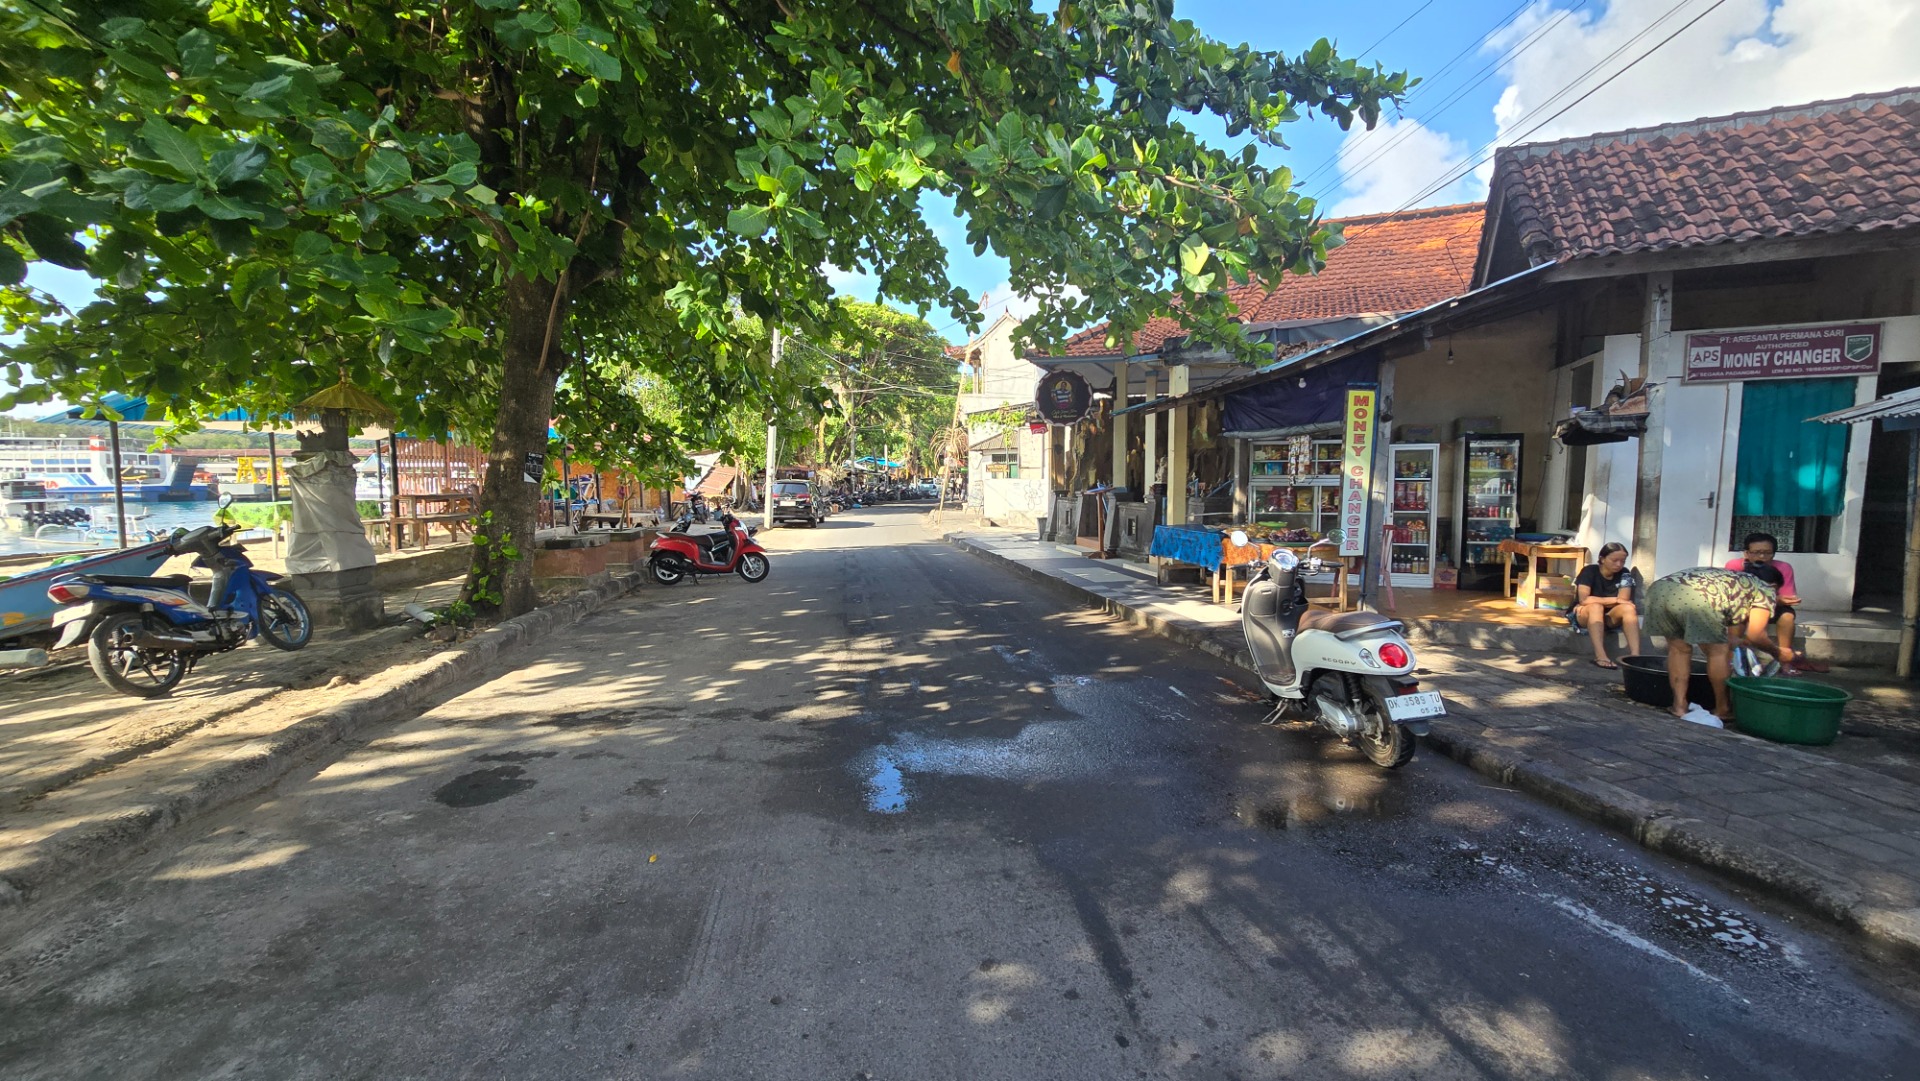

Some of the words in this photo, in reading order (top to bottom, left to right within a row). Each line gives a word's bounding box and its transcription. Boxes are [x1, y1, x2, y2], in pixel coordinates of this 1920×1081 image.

[1720, 336, 1731, 344] PT.
[1732, 333, 1779, 343] ARIESANTA
[1780, 331, 1822, 340] PERMANA
[1823, 329, 1844, 338] SARI
[1755, 341, 1809, 350] AUTHORIZED
[1693, 350, 1719, 363] APS
[1723, 351, 1771, 369] MONEY
[1773, 347, 1841, 366] CHANGER
[1351, 395, 1370, 457] MONEY
[1346, 466, 1364, 551] CHANGER
[1388, 699, 1401, 709] DK
[1404, 695, 1427, 707] 3589
[1428, 693, 1440, 704] TU
